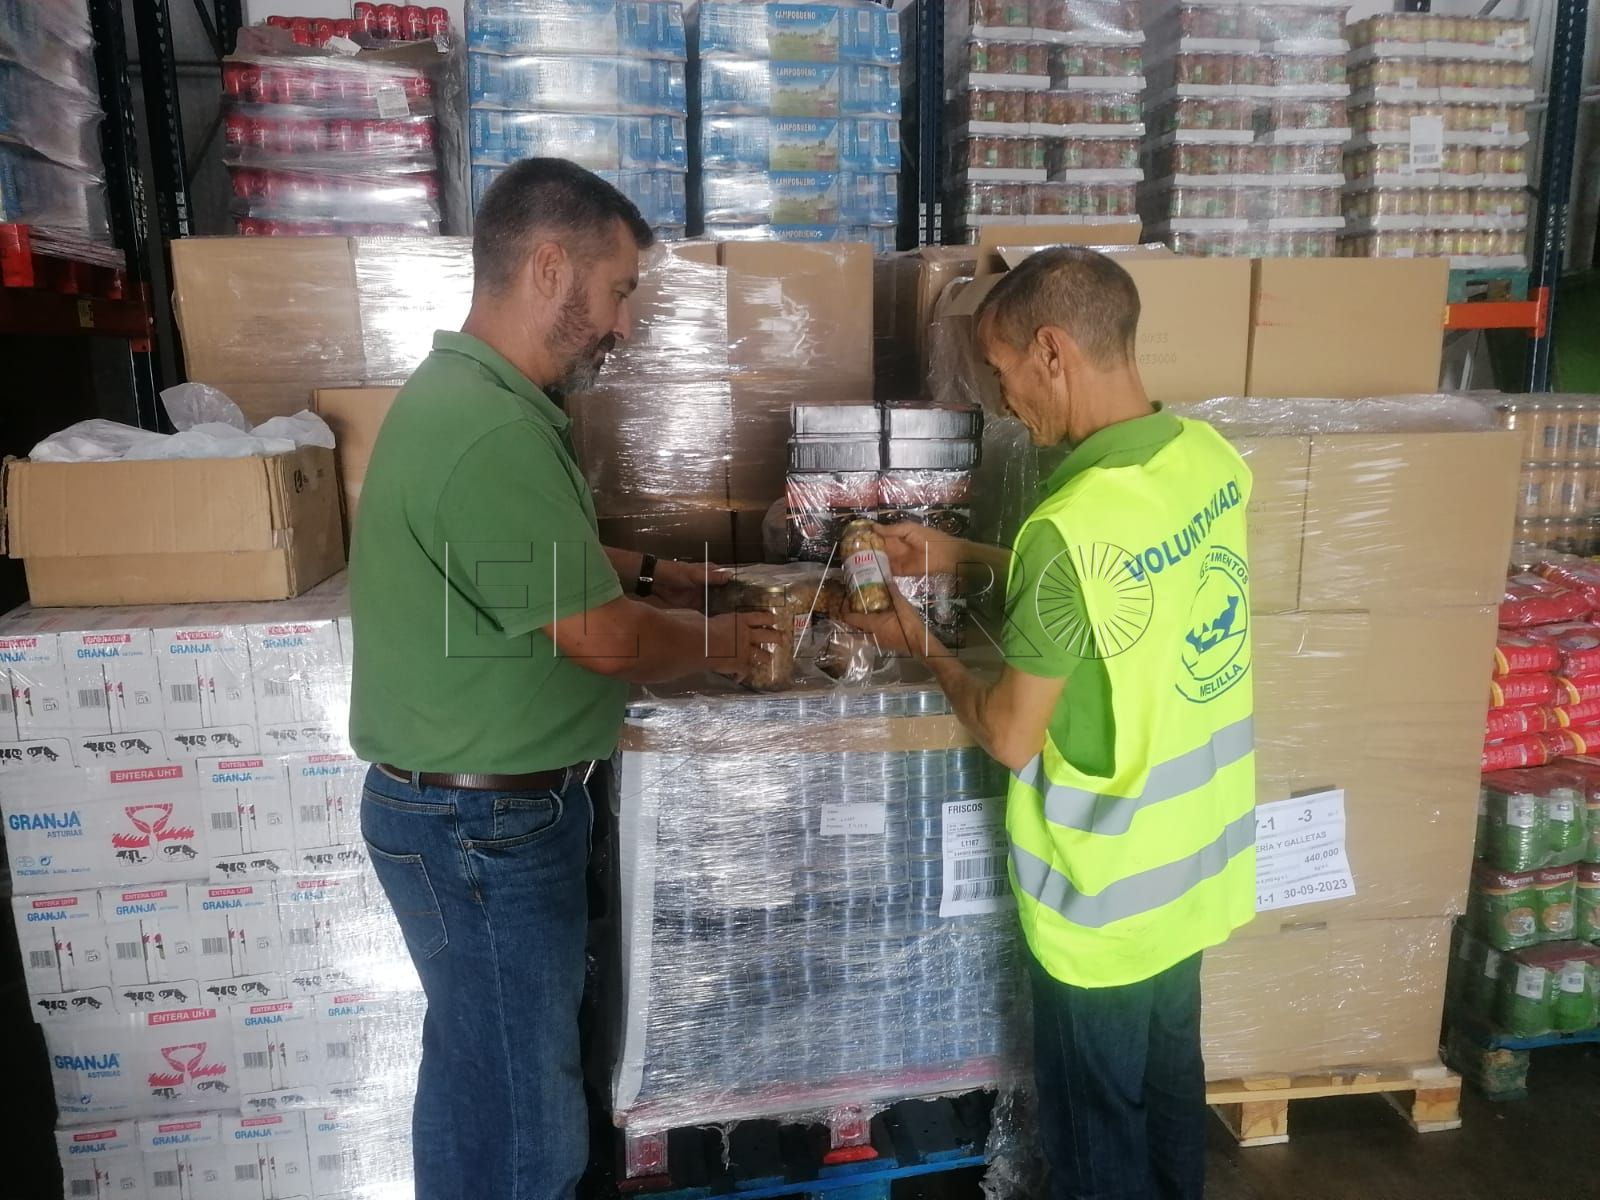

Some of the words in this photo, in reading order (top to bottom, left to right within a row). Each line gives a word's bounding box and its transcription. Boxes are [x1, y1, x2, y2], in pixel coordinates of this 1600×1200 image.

[775, 10, 816, 20] CAMPOBUENO
[1123, 479, 1242, 583] VOLUNTAIAD
[77, 647, 120, 659] GRANJA
[170, 643, 212, 655] GRANJA
[1200, 663, 1244, 697] MELILLA
[115, 770, 154, 781] ENTERA
[157, 768, 178, 778] UHT
[212, 772, 252, 783] GRANJA
[302, 766, 342, 777] GRANJA
[948, 802, 983, 815] FRISCOS
[9, 810, 82, 831] GRANJA
[1297, 809, 1312, 823] -3
[47, 829, 83, 839] ASTURIAS
[1277, 841, 1282, 849] Y
[1284, 831, 1327, 848] GALLETAS
[1304, 847, 1339, 864] 440,000
[1284, 878, 1348, 899] 30-09-2023
[116, 903, 156, 915] GRANJA
[202, 899, 243, 911] GRANJA
[27, 910, 67, 922] GRANJA
[152, 1012, 189, 1023] ENTERA
[192, 1010, 210, 1019] UHT
[244, 1015, 283, 1026] GRANJA
[54, 1053, 120, 1070] GRANJA
[152, 1134, 191, 1146] GRANJA
[234, 1128, 272, 1140] GRANJA
[69, 1143, 106, 1154] GRANJA
